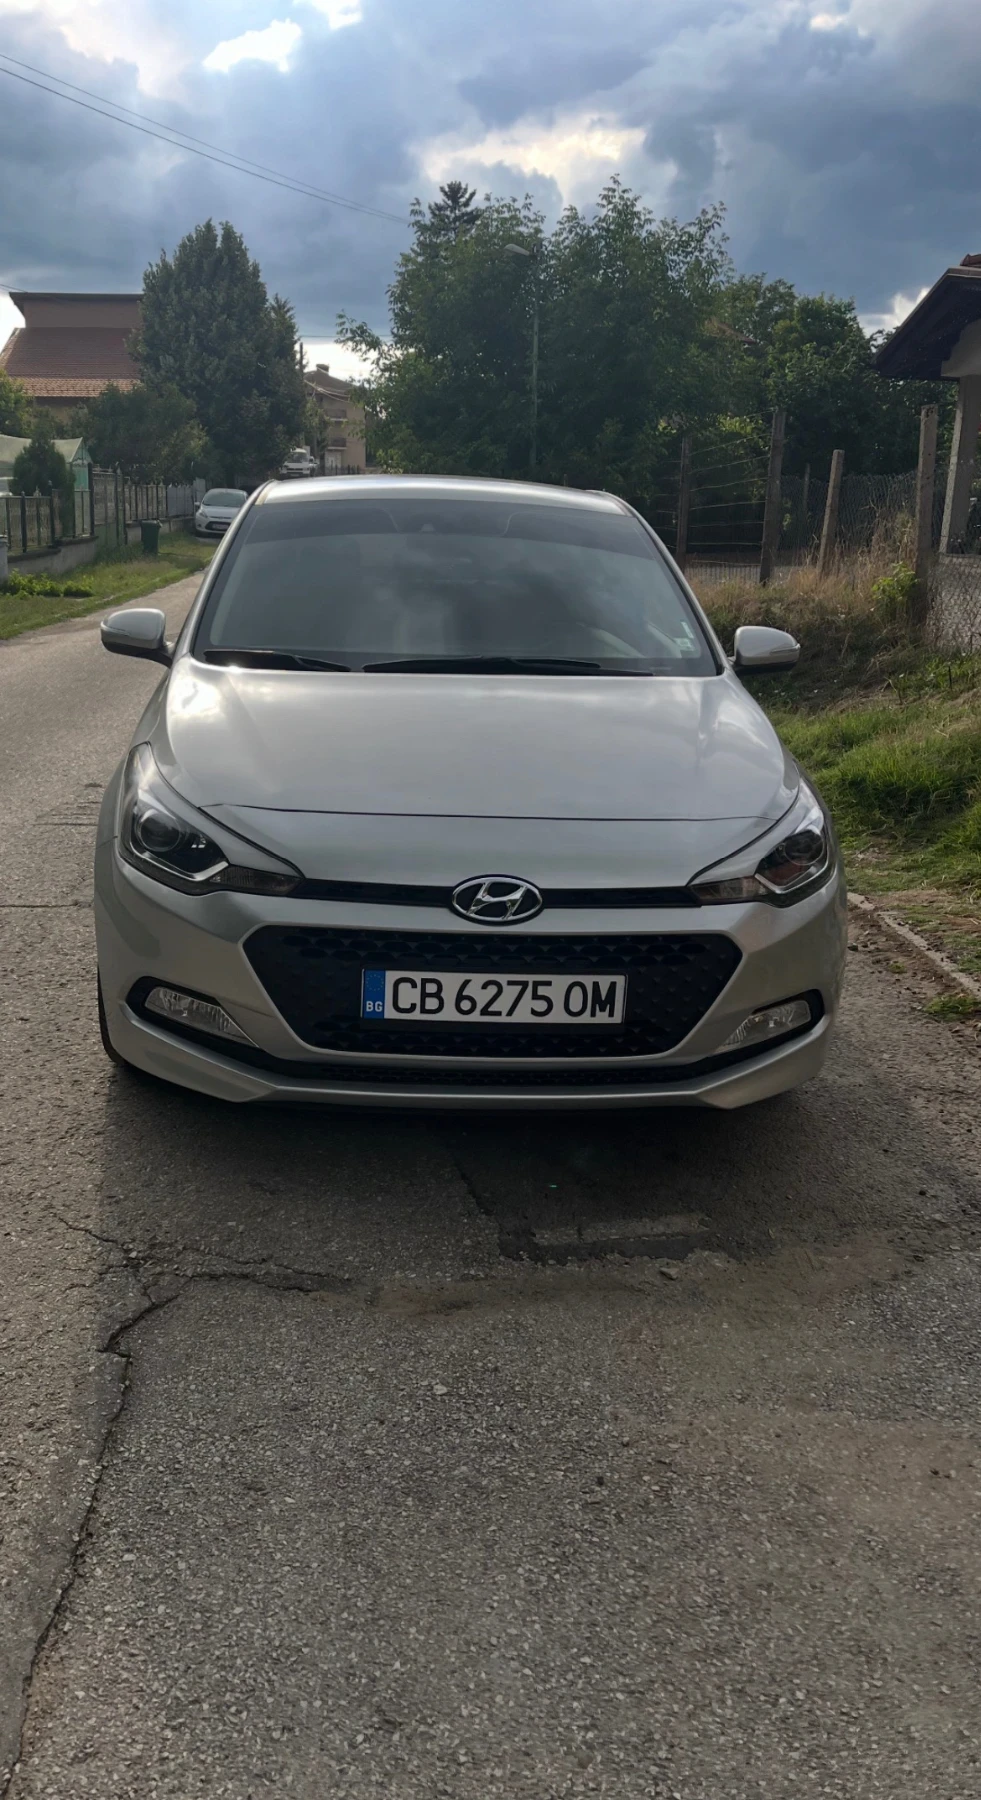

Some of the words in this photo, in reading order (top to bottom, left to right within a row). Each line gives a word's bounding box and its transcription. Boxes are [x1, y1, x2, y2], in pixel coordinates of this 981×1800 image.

[366, 1001, 383, 1012] BG
[392, 977, 445, 1015] CB
[454, 979, 554, 1018] 6275
[563, 981, 618, 1019] OM
